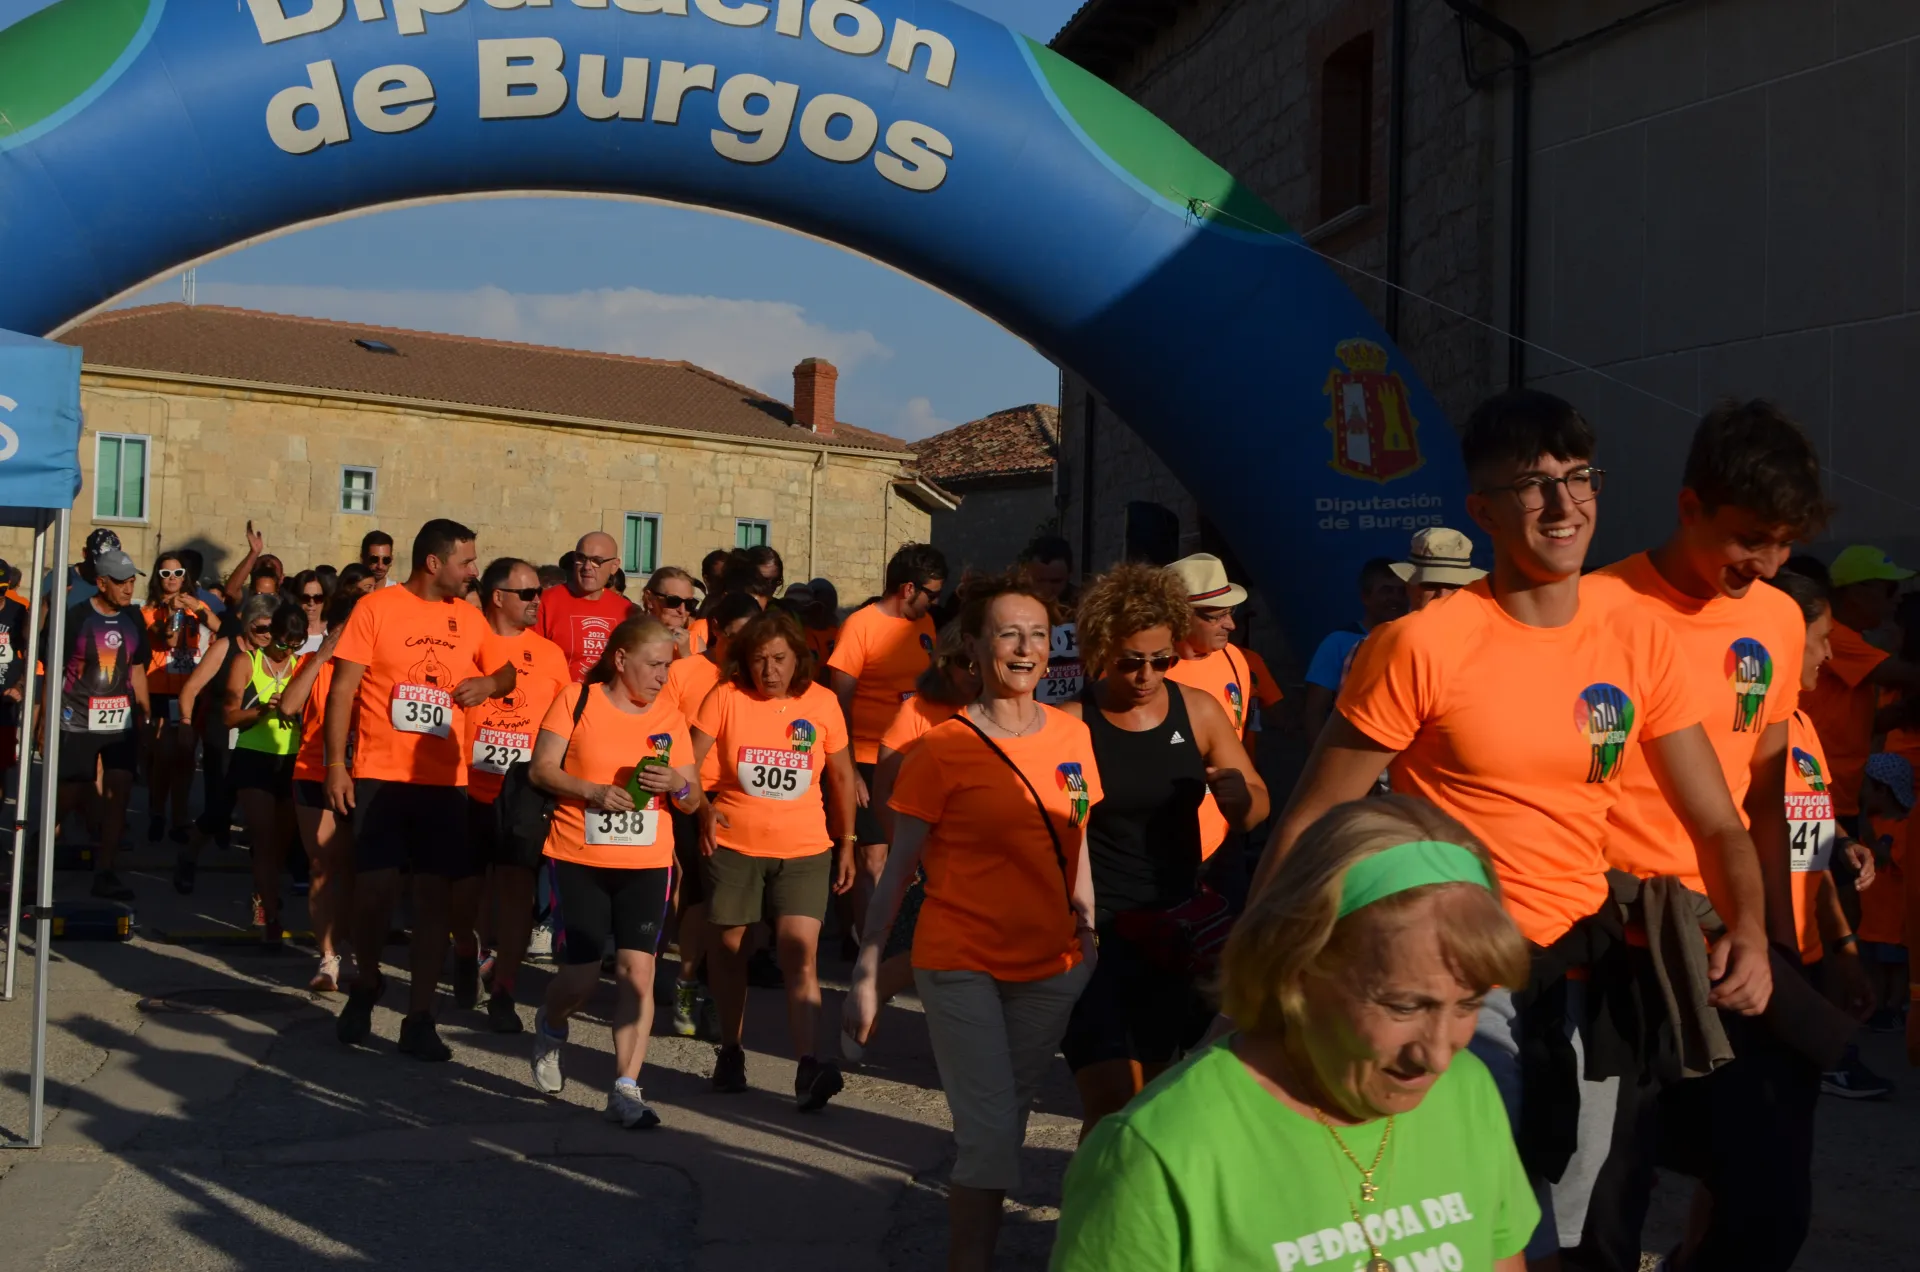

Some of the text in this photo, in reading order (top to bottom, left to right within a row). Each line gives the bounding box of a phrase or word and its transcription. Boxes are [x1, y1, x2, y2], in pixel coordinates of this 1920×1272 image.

[266, 37, 954, 191] de Burgos
[1315, 493, 1442, 514] Diputación
[1318, 514, 1443, 530] de Burgos
[404, 635, 456, 650] Cañizar
[1048, 669, 1080, 678] URGOS
[1047, 678, 1076, 697] 234
[399, 691, 451, 708] BURGOS
[98, 709, 124, 723] 277
[405, 702, 443, 727] 350
[480, 728, 529, 741] DIPUTACIÓN
[480, 735, 529, 748] BURGOS
[484, 745, 521, 766] 232
[745, 754, 808, 769] BURGOS
[746, 749, 808, 761] DIPUTACIÓN
[752, 766, 797, 791] 305
[598, 811, 644, 834] 338
[1788, 822, 1821, 855] 41
[1272, 1192, 1473, 1272] PEDROSA DEL
